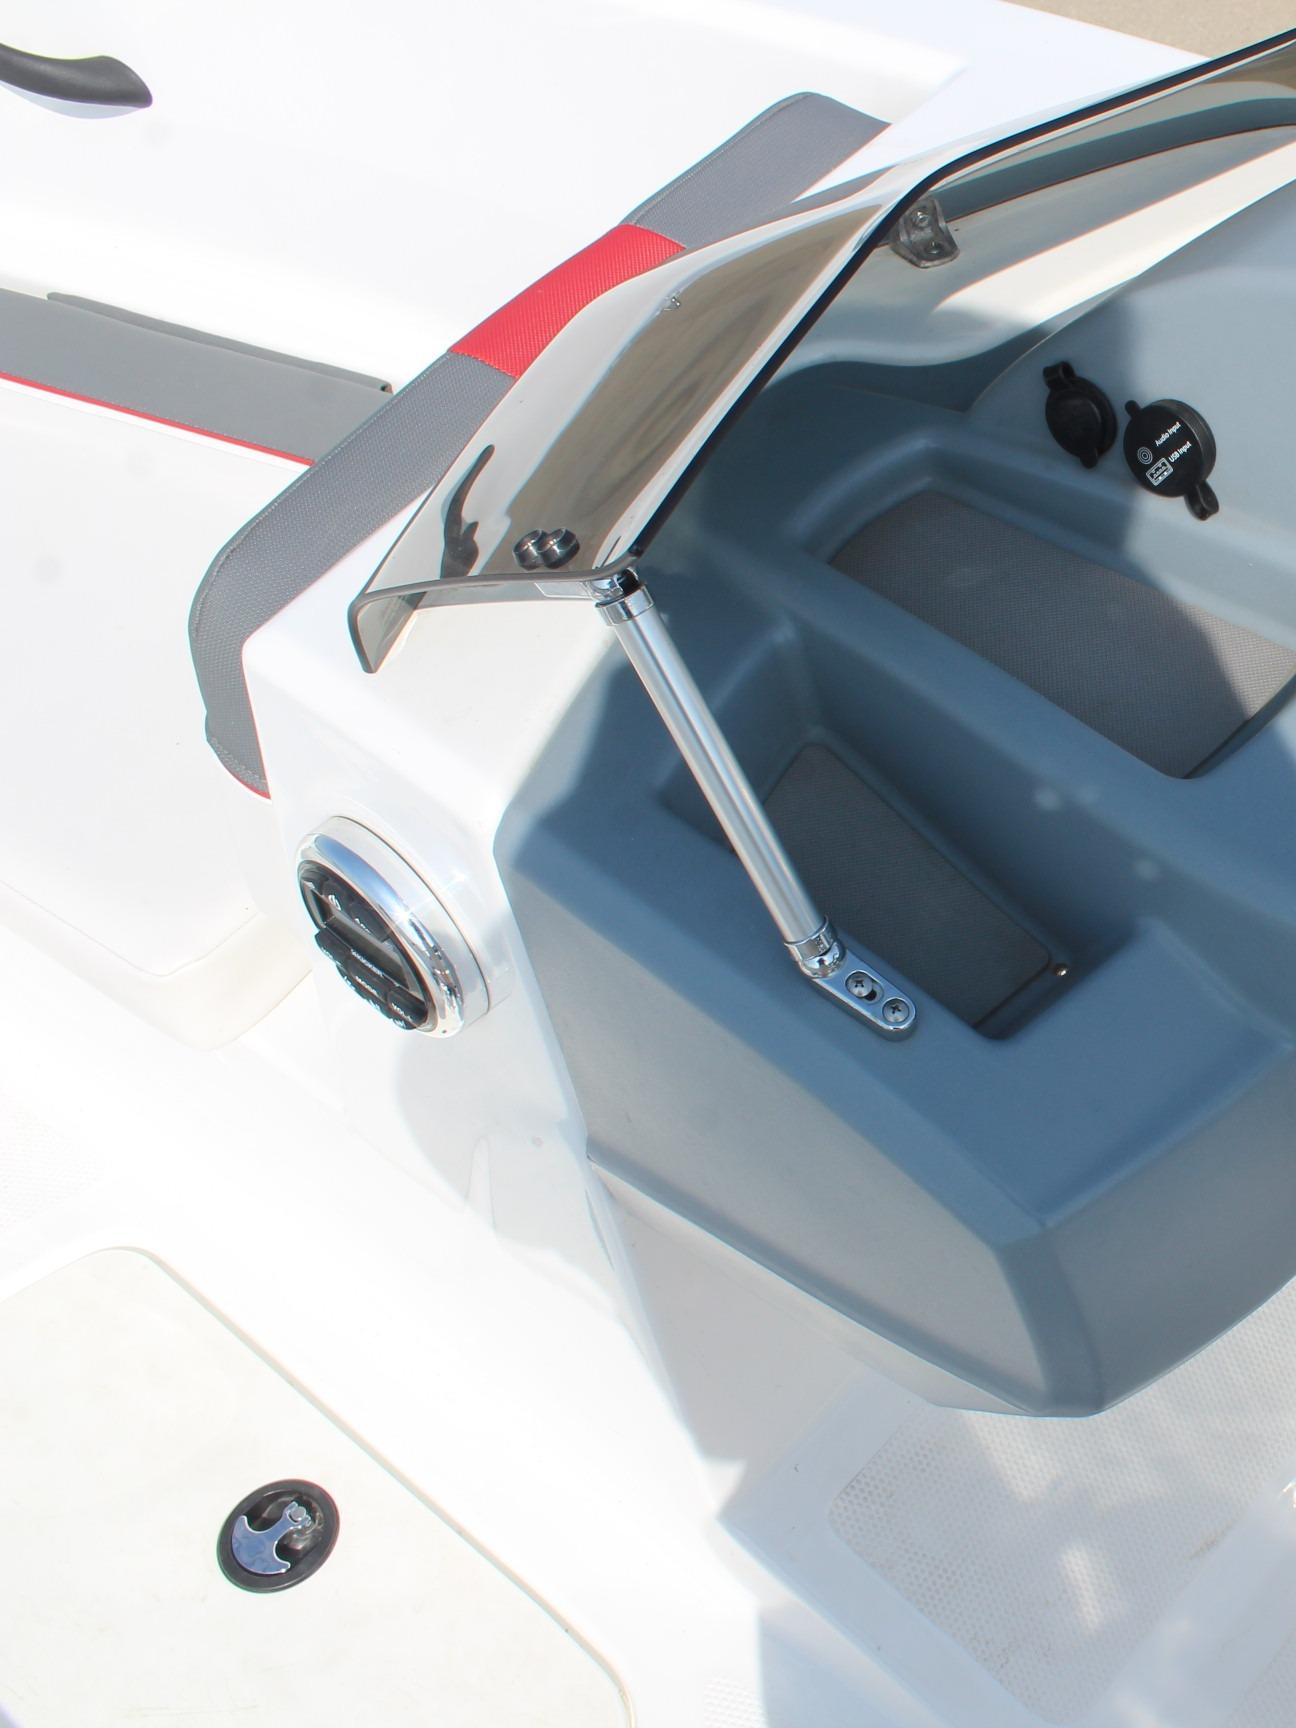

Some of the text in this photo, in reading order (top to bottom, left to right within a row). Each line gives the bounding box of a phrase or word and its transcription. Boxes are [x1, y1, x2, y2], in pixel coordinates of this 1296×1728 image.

[1155, 421, 1181, 447] Audio Input
[1168, 441, 1192, 463] USB Input
